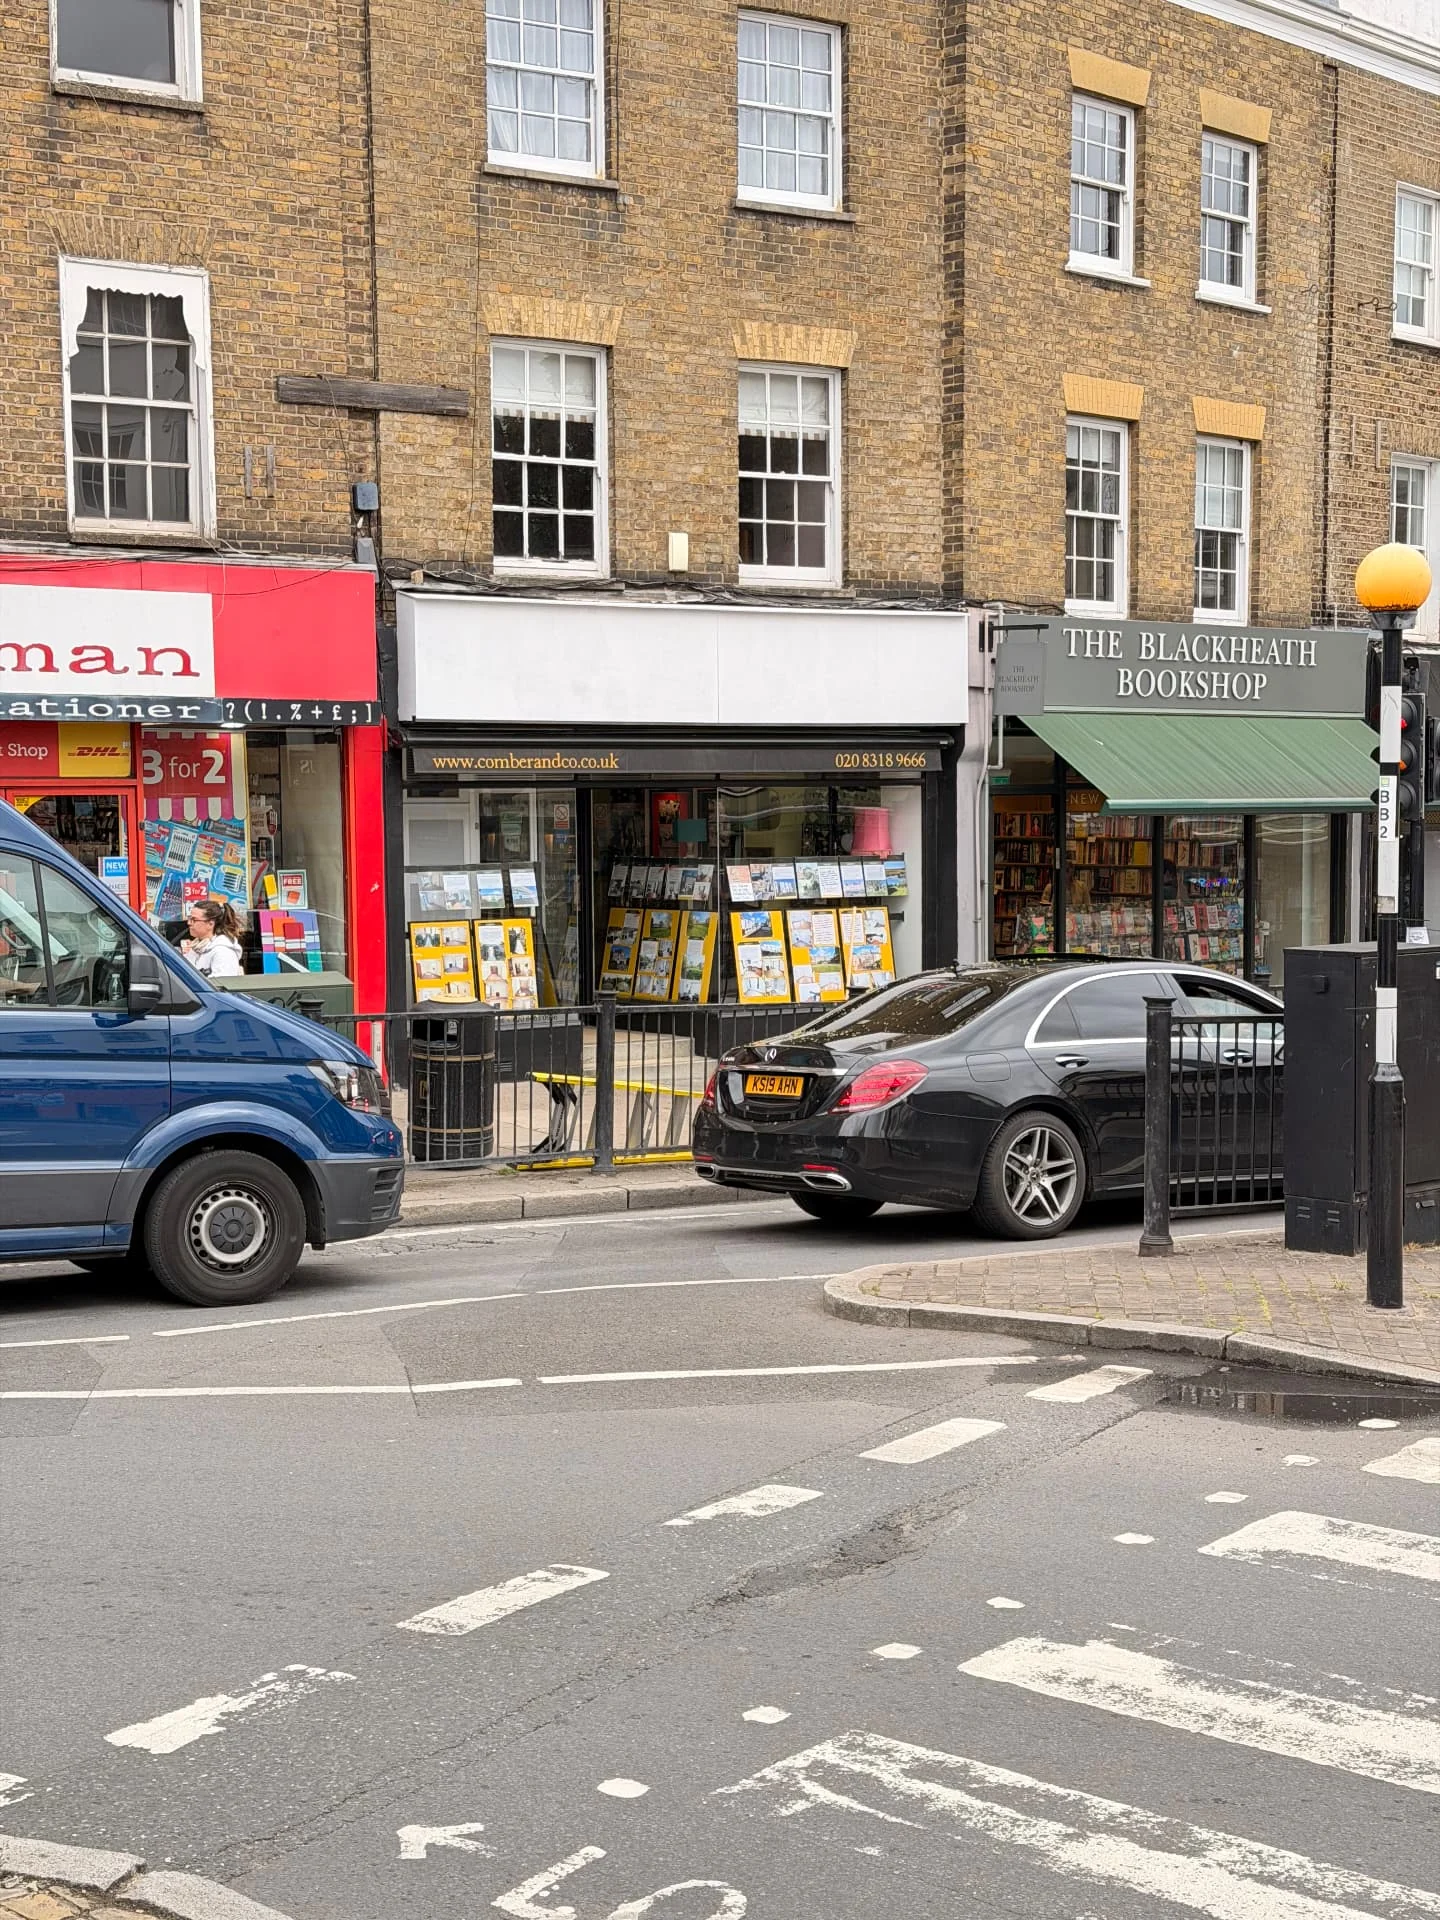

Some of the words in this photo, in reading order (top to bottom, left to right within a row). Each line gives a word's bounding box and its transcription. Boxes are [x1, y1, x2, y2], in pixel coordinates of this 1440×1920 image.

[1062, 627, 1123, 660] THE
[1138, 630, 1318, 667] BLACKHEATH
[1116, 667, 1268, 700] BOOKSHOP
[8, 743, 49, 760] Shop
[75, 746, 121, 757] DHL
[835, 753, 860, 768] 020
[862, 752, 894, 768] 8318
[896, 751, 927, 768] 9666
[142, 749, 164, 785] 3
[168, 756, 200, 778] for
[202, 749, 226, 784] 2
[432, 752, 620, 769] www.comberandco.co.uk
[1070, 791, 1100, 805] NEW
[106, 861, 128, 870] NEW
[282, 876, 303, 886] FREE
[751, 1075, 776, 1093] KS19
[776, 1077, 799, 1094] AHN
